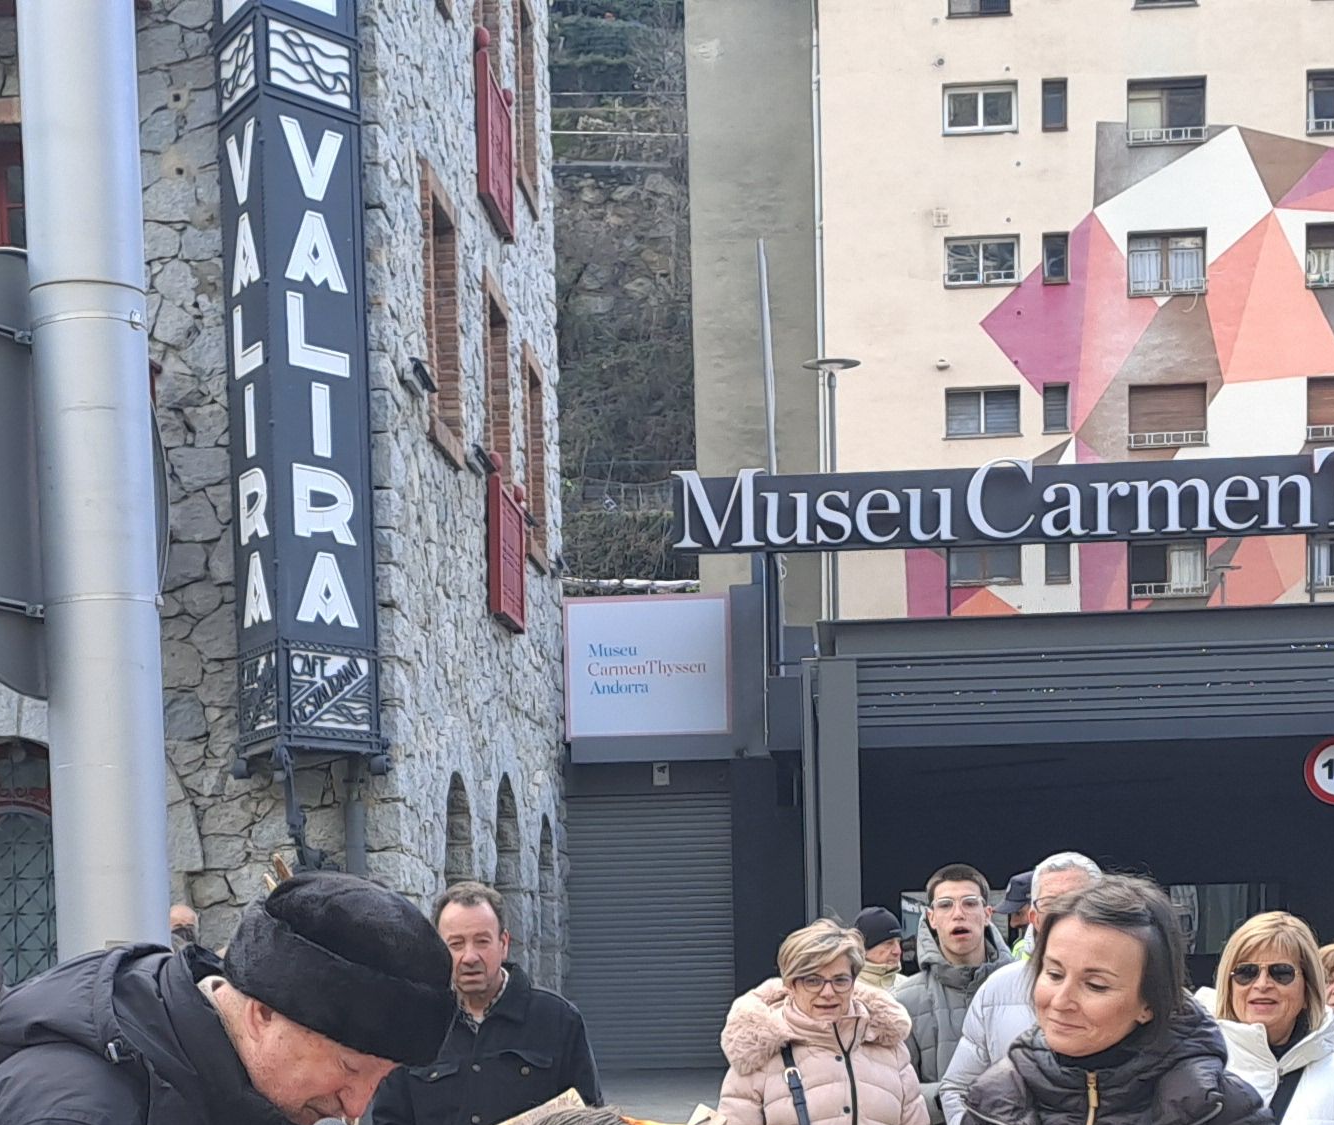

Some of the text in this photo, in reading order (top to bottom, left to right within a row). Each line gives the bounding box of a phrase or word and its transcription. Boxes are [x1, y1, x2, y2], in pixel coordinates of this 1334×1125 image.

[226, 117, 271, 629] VALIRA
[278, 115, 359, 629] VALIRA
[588, 643, 638, 658] Museu
[589, 680, 649, 695] Andorra
